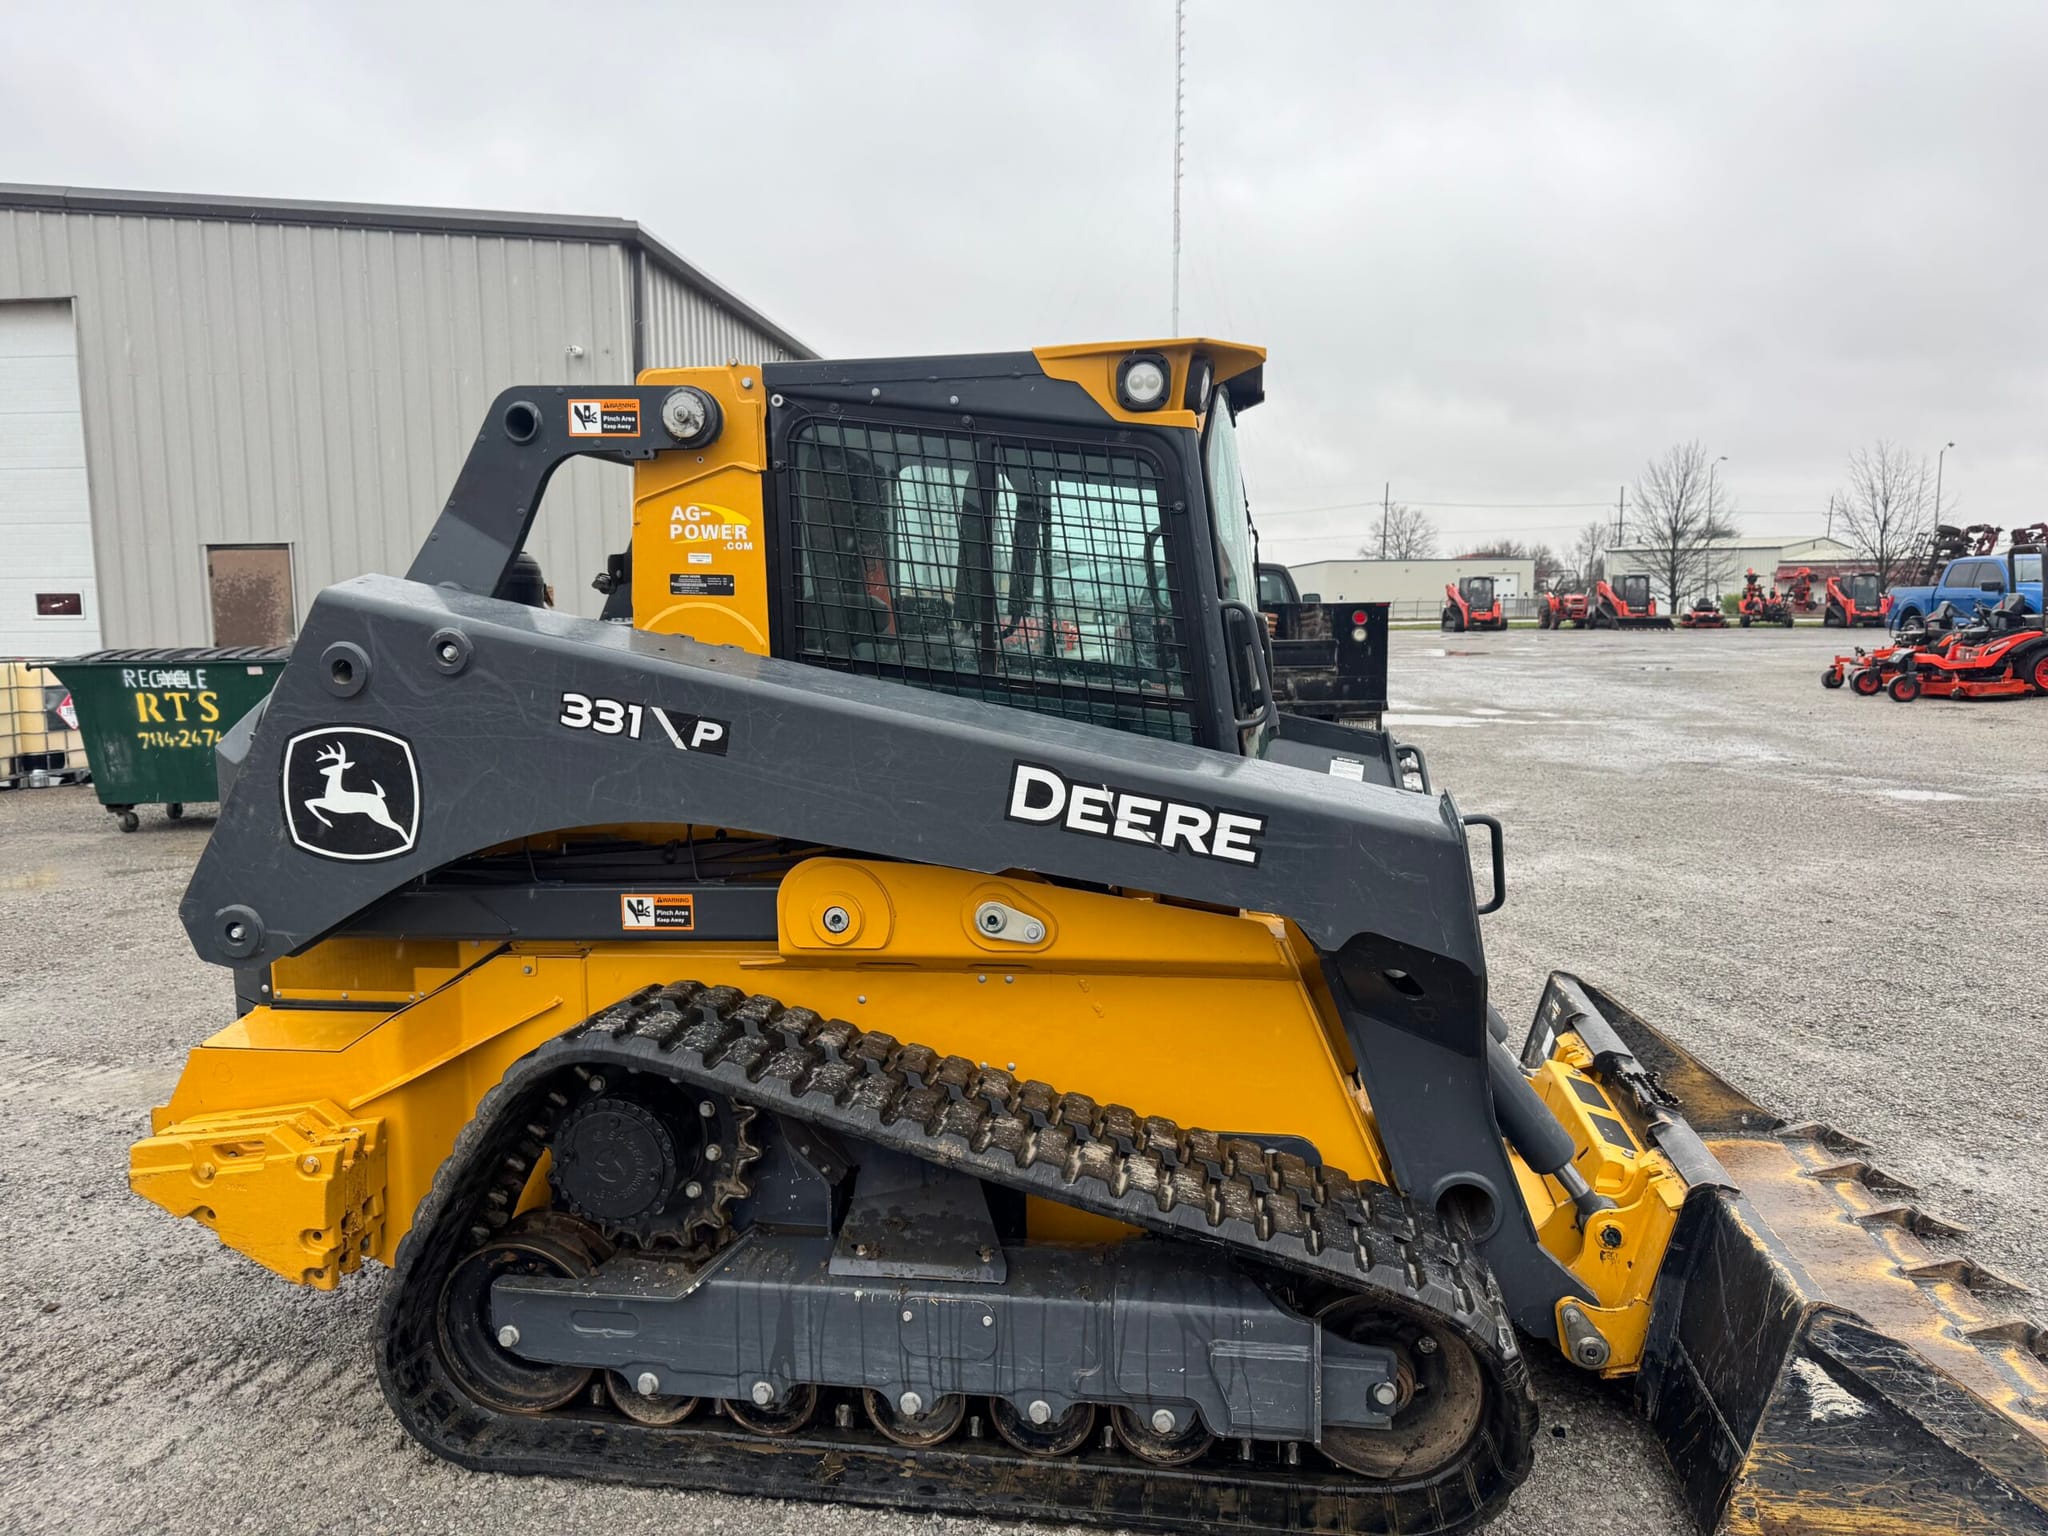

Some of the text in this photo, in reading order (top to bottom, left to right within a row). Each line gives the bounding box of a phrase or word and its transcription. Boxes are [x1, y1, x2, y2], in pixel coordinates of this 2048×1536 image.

[670, 505, 711, 521] AG-
[669, 523, 748, 540] POWER
[723, 542, 753, 551] .COM
[135, 690, 220, 723] RTS
[560, 692, 643, 739] 331
[1009, 764, 1263, 863] DEERE
